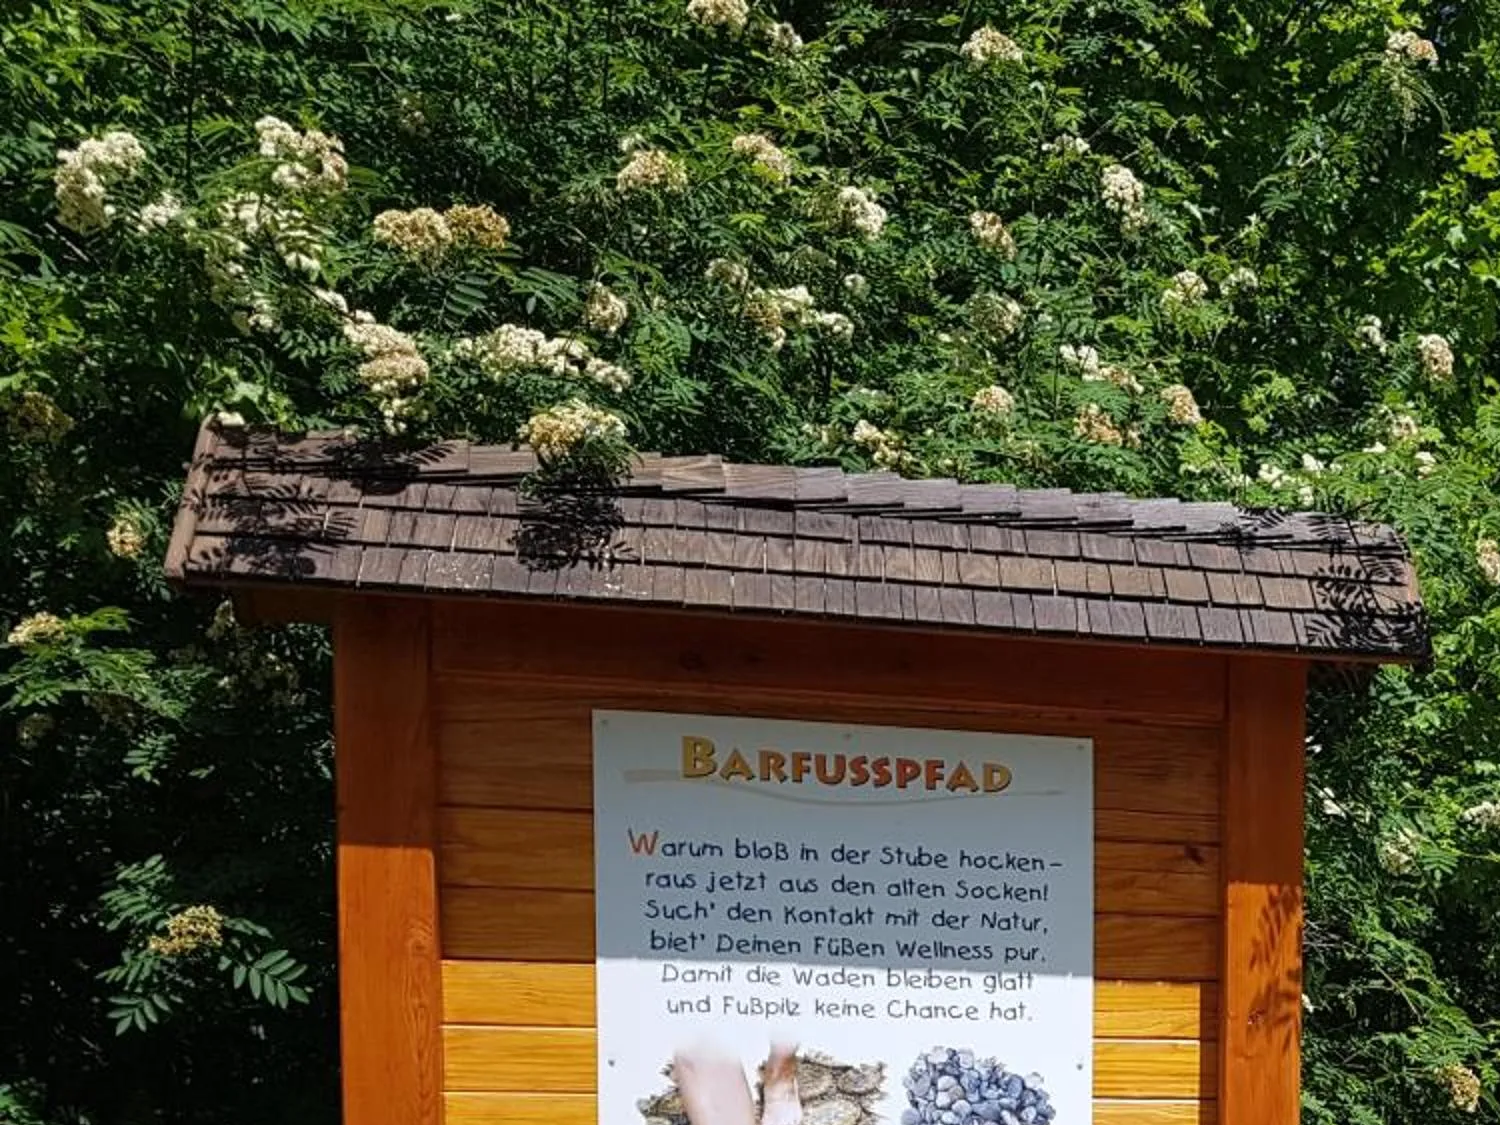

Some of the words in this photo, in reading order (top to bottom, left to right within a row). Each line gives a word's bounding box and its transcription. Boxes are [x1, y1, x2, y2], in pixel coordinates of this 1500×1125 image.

[680, 735, 1013, 793] BARFUSSPFAD
[628, 828, 723, 857] Warum
[800, 843, 819, 861] in
[831, 843, 870, 865] der
[880, 846, 948, 868] Stube
[645, 871, 697, 889] raus
[706, 871, 767, 893] jetzt
[779, 877, 819, 893] aus
[831, 874, 875, 896] den
[887, 877, 945, 899] alten
[955, 879, 1049, 902] Socken!
[727, 901, 772, 923] den
[784, 904, 874, 926] Kontakt
[885, 908, 919, 926] mit
[931, 909, 971, 930] der
[980, 911, 1048, 935] Natur,
[716, 932, 802, 955] Deinen
[896, 939, 993, 961] Wellness
[1003, 946, 1046, 964] pur.
[661, 963, 733, 984] Damit
[746, 965, 781, 985] die
[792, 966, 875, 988] Waden
[886, 967, 972, 990] bleiben
[983, 971, 1034, 994] glatt
[667, 995, 711, 1014] und
[814, 998, 876, 1019] keine
[887, 999, 980, 1021] Chance
[989, 1001, 1033, 1022] hat.
